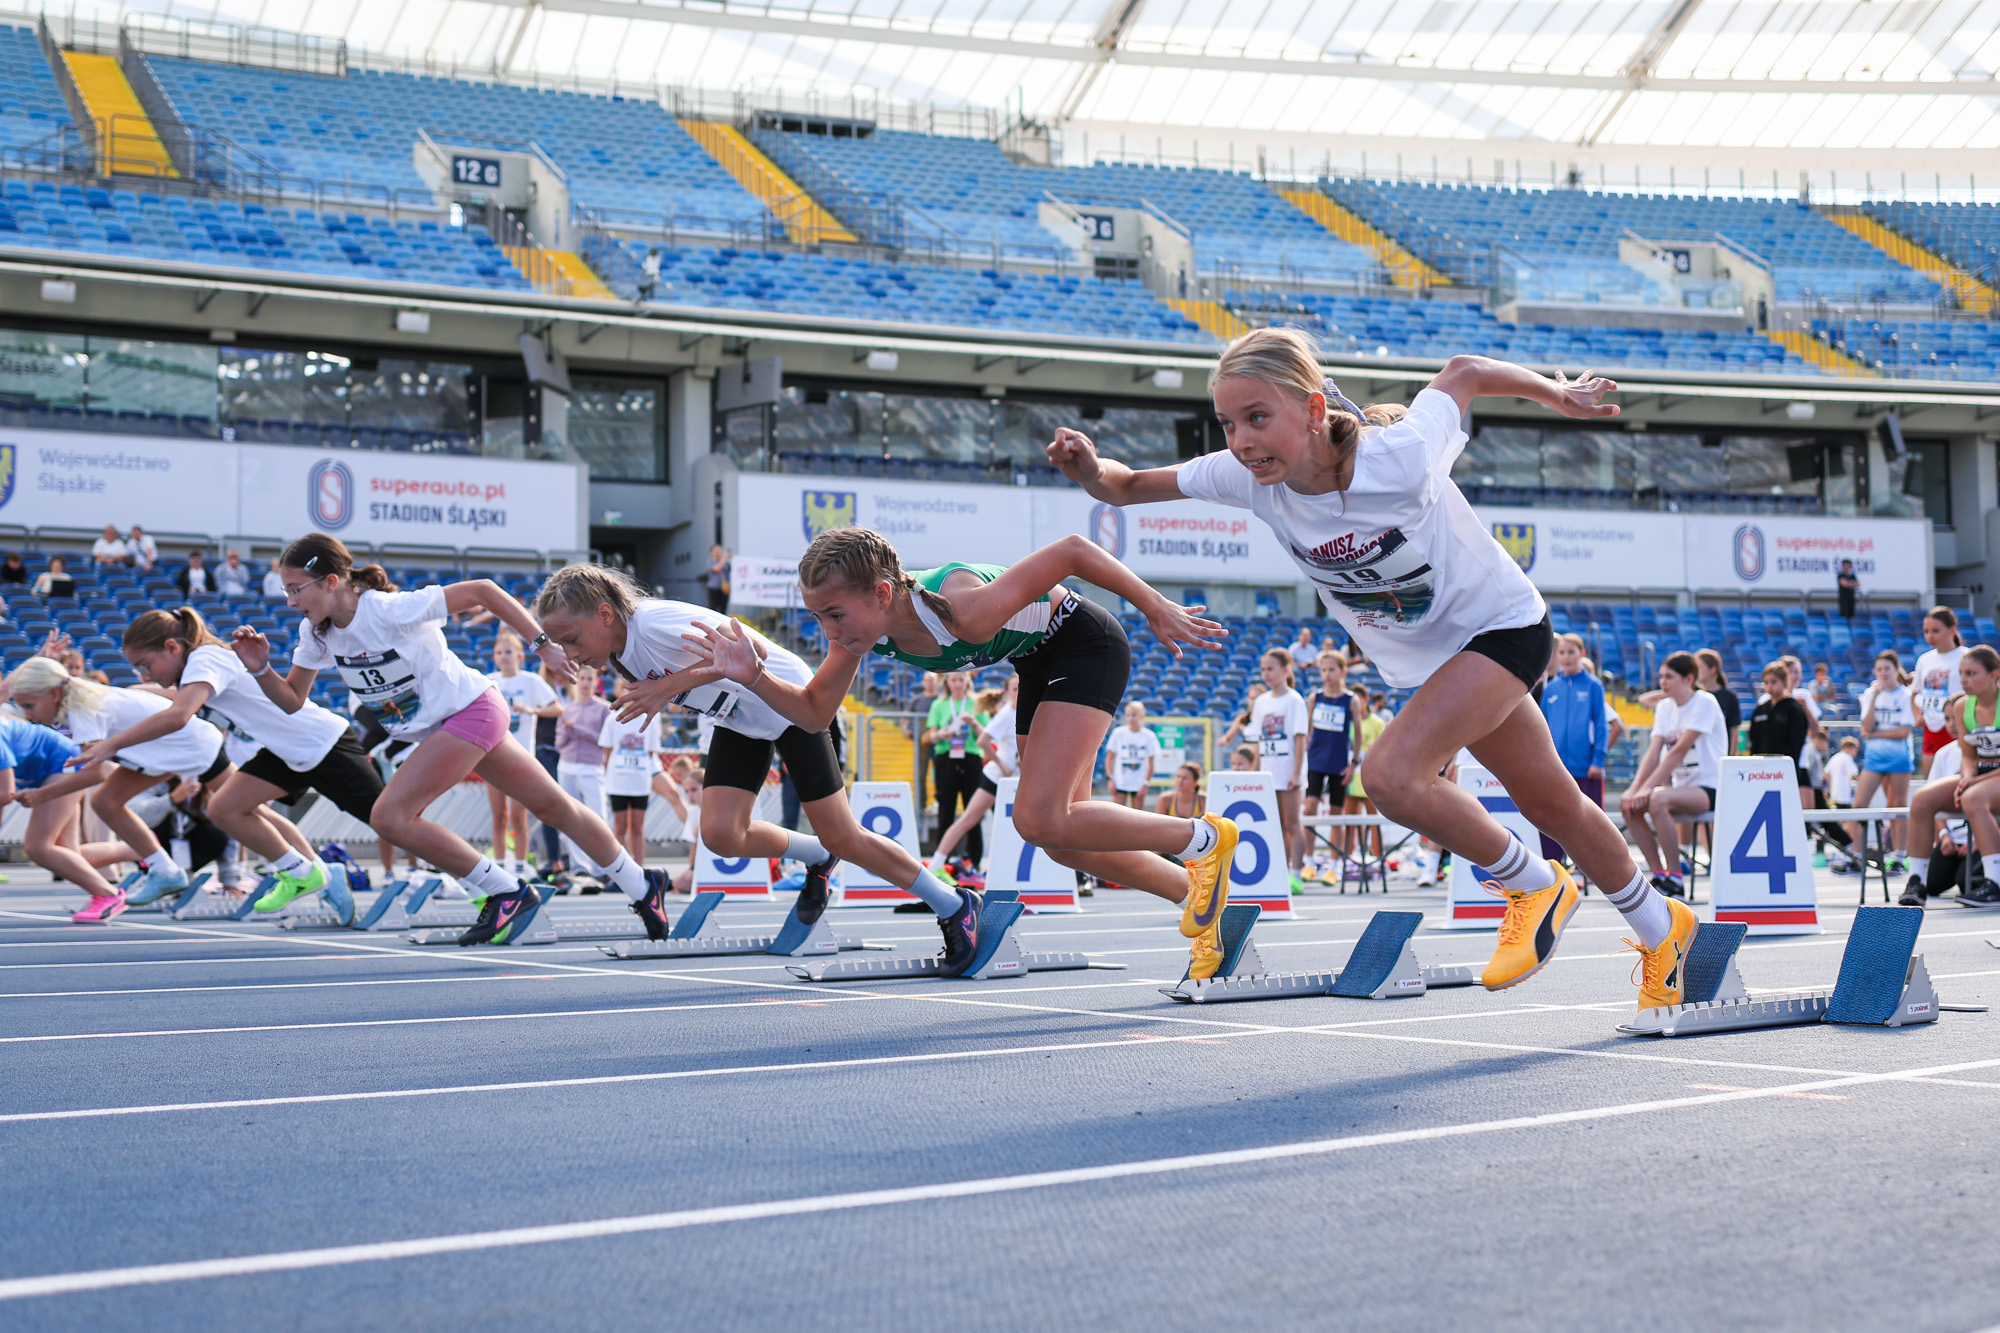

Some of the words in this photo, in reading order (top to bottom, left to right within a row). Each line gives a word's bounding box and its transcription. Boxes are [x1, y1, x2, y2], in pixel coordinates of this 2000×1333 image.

[455, 159, 482, 182] 12
[38, 448, 171, 472] Województwo
[37, 469, 106, 496] Śląskie
[370, 477, 506, 502] superauto.pl
[369, 502, 443, 524] STADION
[447, 503, 506, 531] ŚLĄSKI
[874, 495, 978, 515] Województwo
[874, 515, 927, 535] Śląskie
[1139, 516, 1249, 535] superauto.pl
[1138, 538, 1198, 558] STADION
[1202, 538, 1249, 562] ŚLĄSKI
[1309, 532, 1357, 560] ANUSZ
[1776, 538, 1874, 553] superauto.pl
[1776, 557, 1830, 573] STADION
[1832, 554, 1876, 573] ŚSKI
[1333, 568, 1382, 584] 19
[1040, 593, 1079, 646] NIKE
[358, 669, 386, 687] 13
[1232, 783, 1265, 793] polanik
[1748, 771, 1785, 782] polanik
[1221, 800, 1271, 887] 6
[1730, 790, 1797, 895] 4
